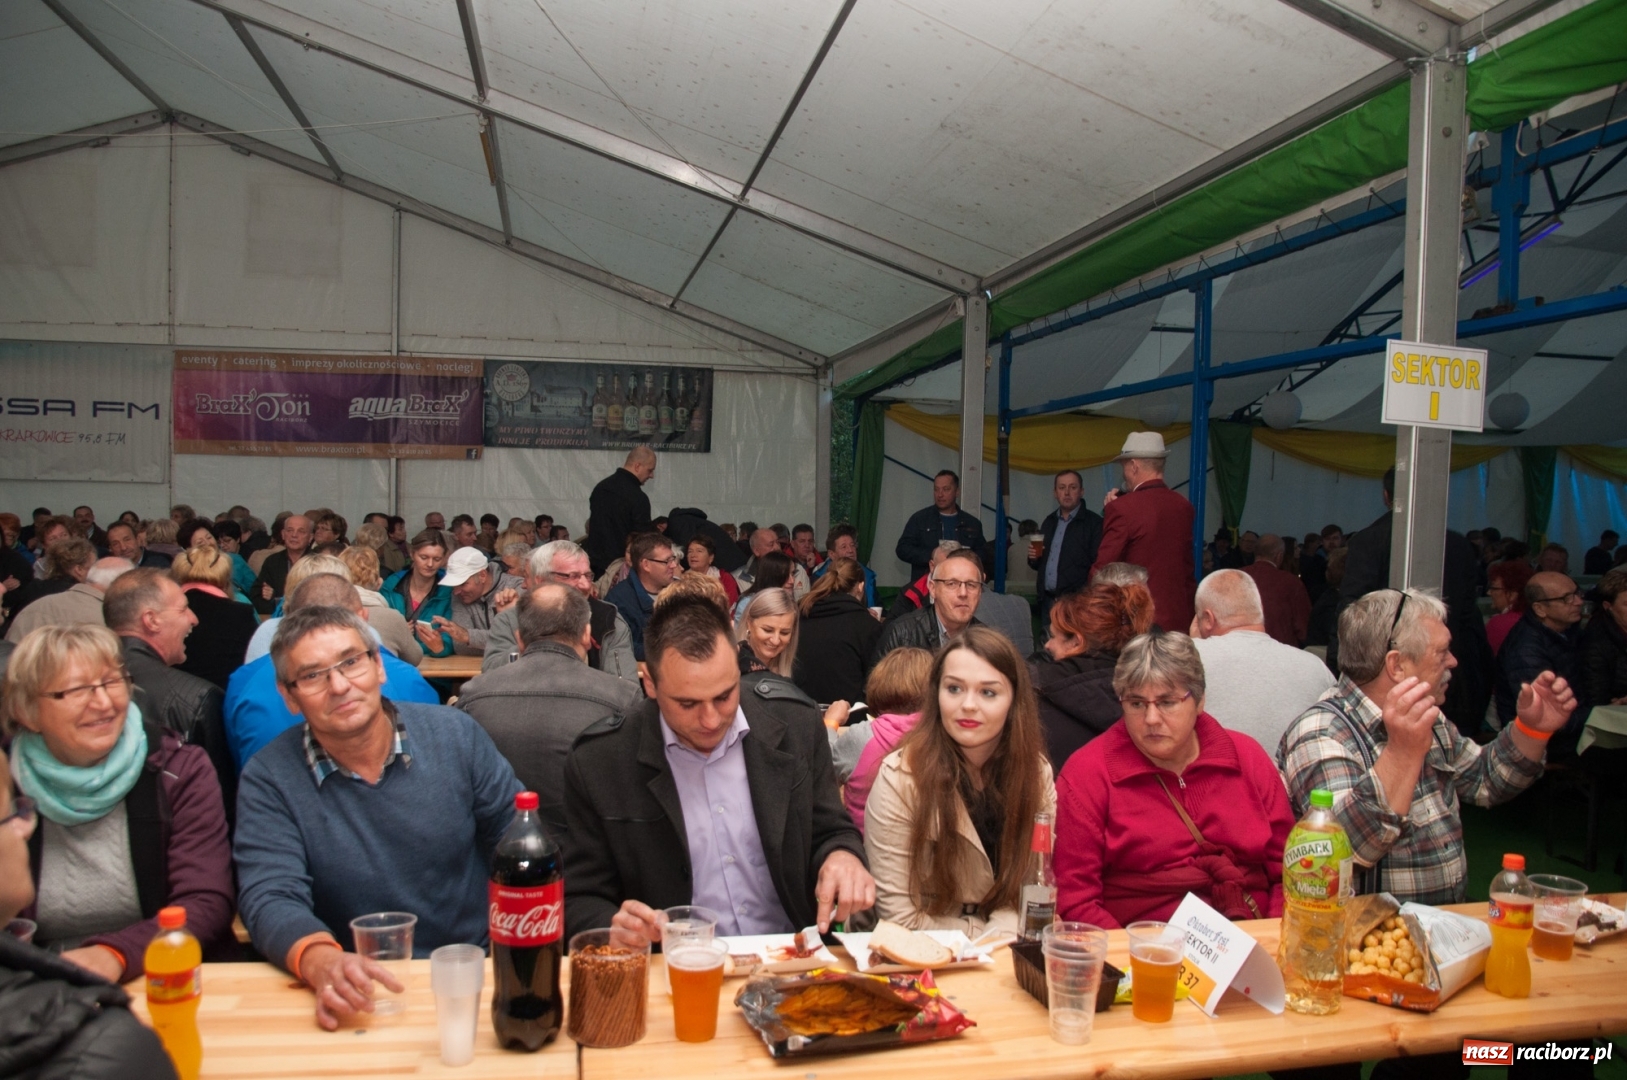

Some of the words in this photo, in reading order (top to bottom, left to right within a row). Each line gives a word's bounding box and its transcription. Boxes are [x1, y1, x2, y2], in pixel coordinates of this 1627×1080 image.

[181, 355, 218, 367] eventy
[233, 356, 277, 368] catering
[291, 357, 334, 370] imprezy
[336, 358, 421, 370] okolicznościowe
[436, 362, 474, 373] noclegi
[1391, 351, 1481, 391] SEKTOR
[0, 398, 75, 417] SA
[92, 400, 160, 420] FM
[408, 419, 460, 427] SZYMOCICE
[499, 426, 512, 434] MY
[514, 427, 538, 435] PIWO
[540, 427, 589, 436] TWORZYMY
[0, 428, 77, 444] KRAPKOWICE
[106, 432, 126, 445] FM
[519, 437, 531, 445] JE
[295, 445, 366, 455] www.braxton.pl
[498, 890, 524, 898] ORIGINAL
[490, 900, 561, 938] Coca-Cola
[1182, 930, 1213, 959] SEKTOR
[1183, 971, 1200, 990] 37
